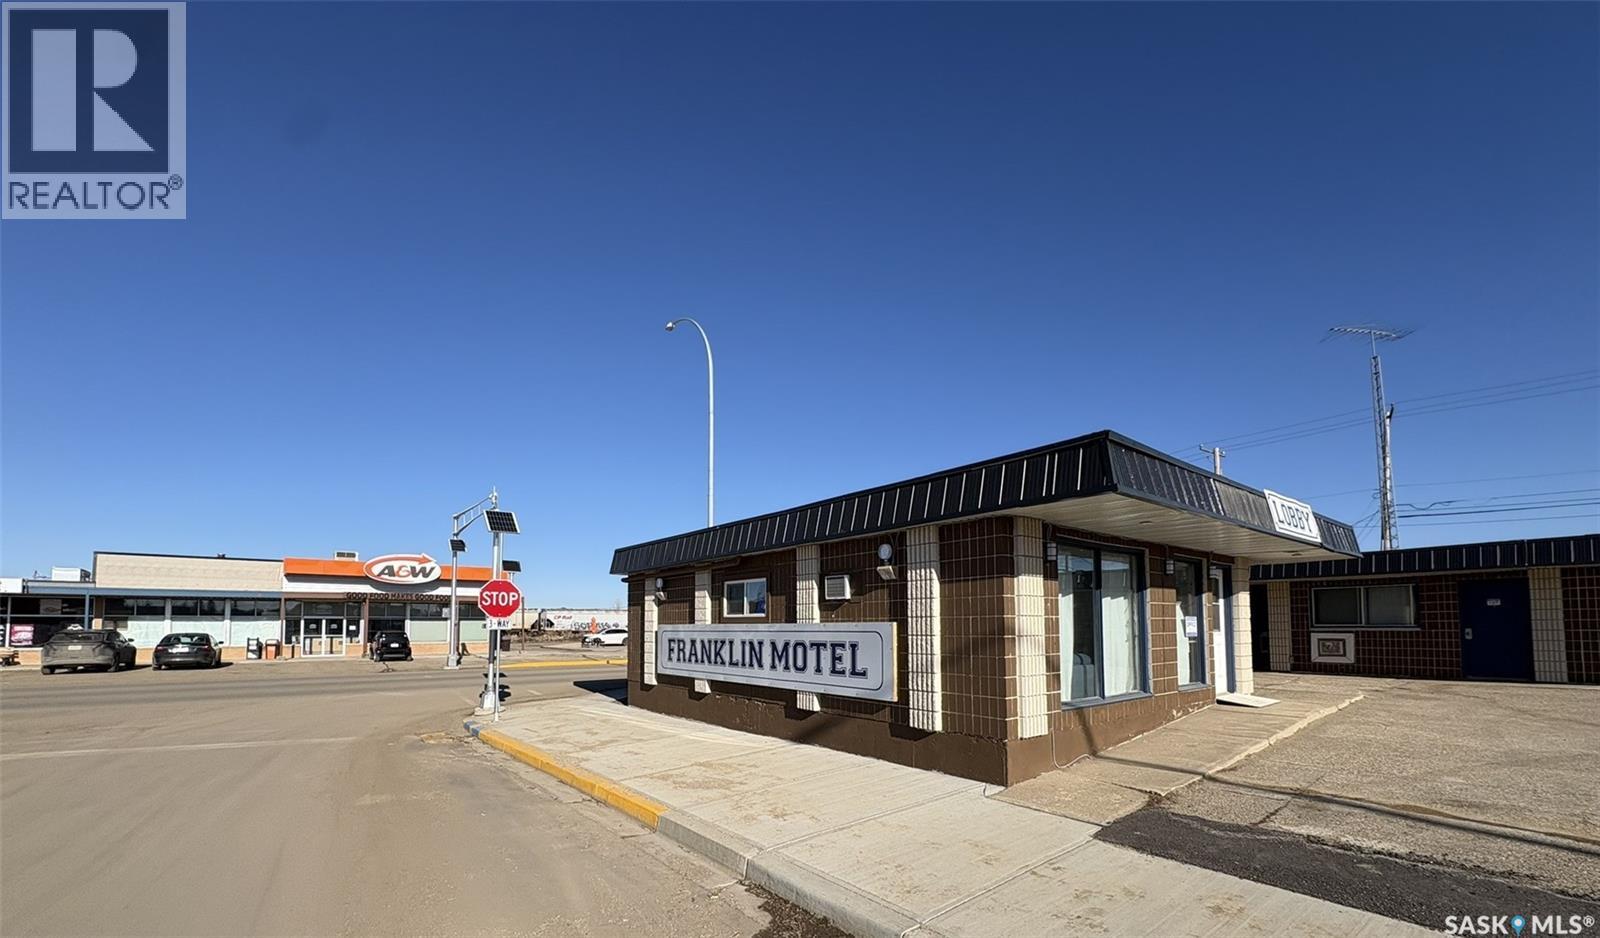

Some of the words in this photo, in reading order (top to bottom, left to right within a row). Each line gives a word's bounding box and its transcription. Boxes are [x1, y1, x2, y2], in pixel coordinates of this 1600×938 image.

[1272, 500, 1312, 533] LOBBY
[376, 564, 436, 578] A&W
[369, 592, 390, 600] FOOD
[391, 592, 414, 601] MAKES
[414, 593, 434, 601] GOOD
[481, 591, 519, 607] STOP
[667, 638, 764, 670] FRANKLIN
[768, 640, 869, 680] MOTEL
